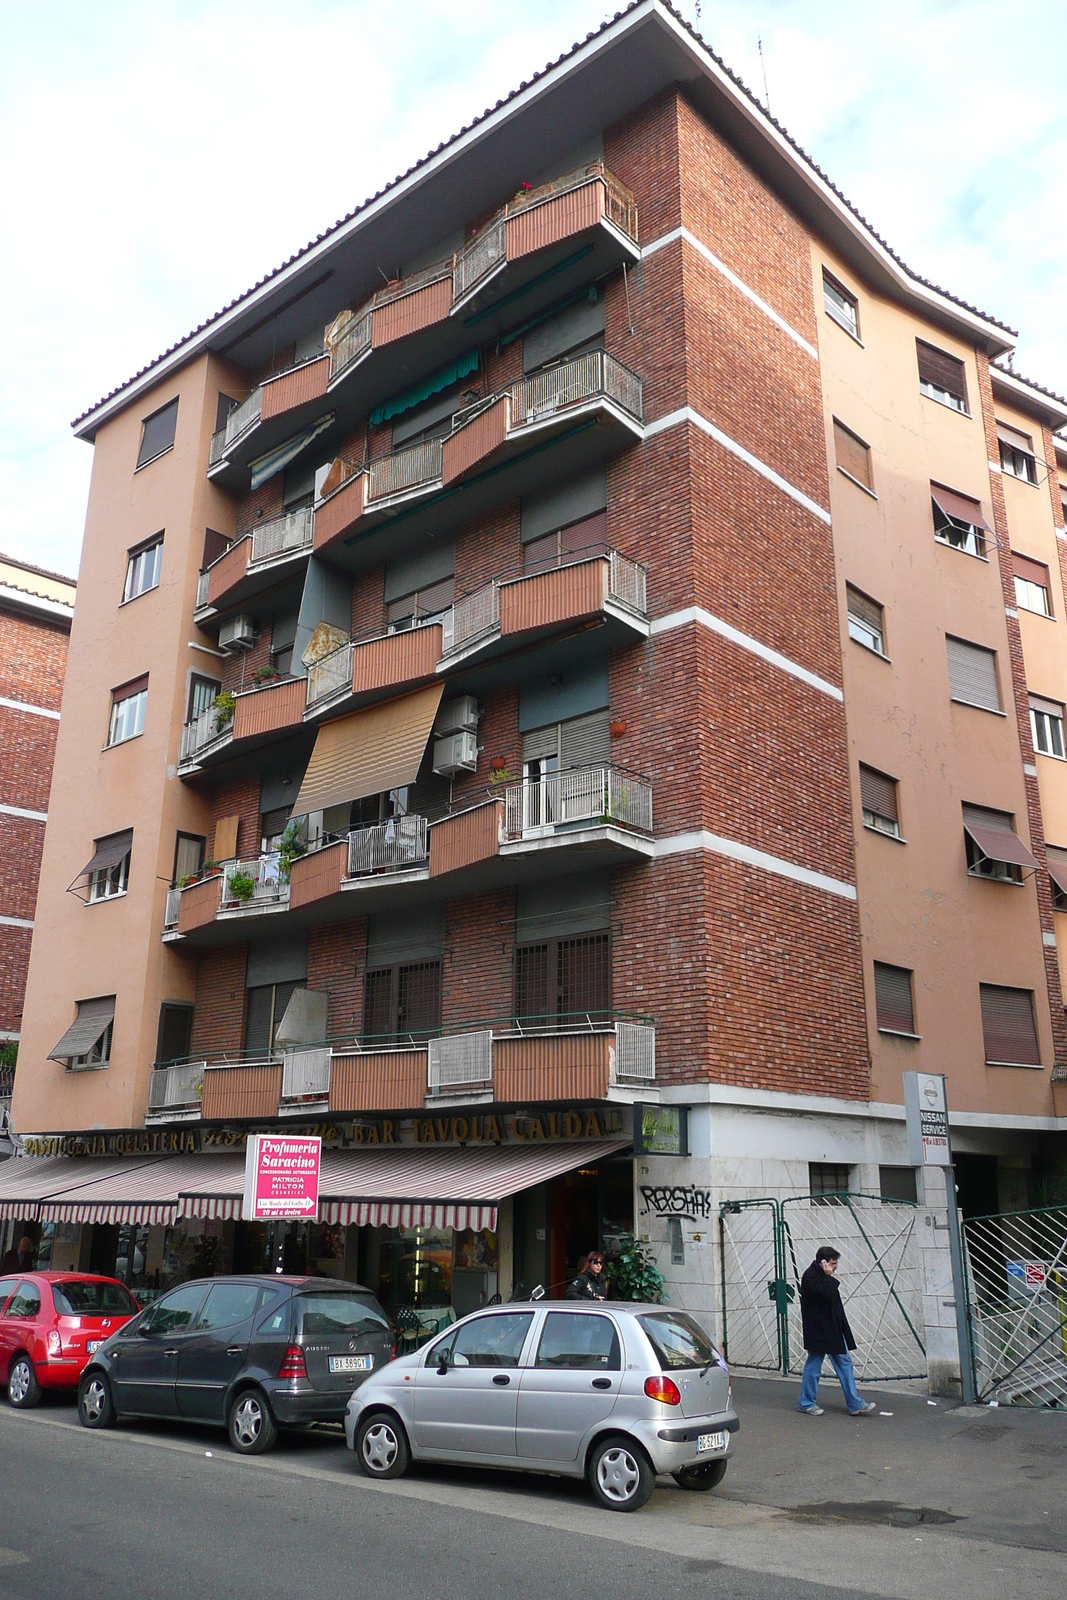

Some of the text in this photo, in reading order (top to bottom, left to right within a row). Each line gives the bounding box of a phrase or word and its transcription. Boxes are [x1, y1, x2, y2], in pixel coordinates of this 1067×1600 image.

[920, 1112, 946, 1123] NISSAN
[353, 1110, 602, 1143] BAR TAVOLA CALDA
[922, 1124, 946, 1135] SERVICE
[25, 1131, 195, 1155] PASTICCERIA GELATERIA
[261, 1141, 317, 1156] Profumeria
[261, 1154, 315, 1168] Saracino
[641, 1167, 649, 1175] 79
